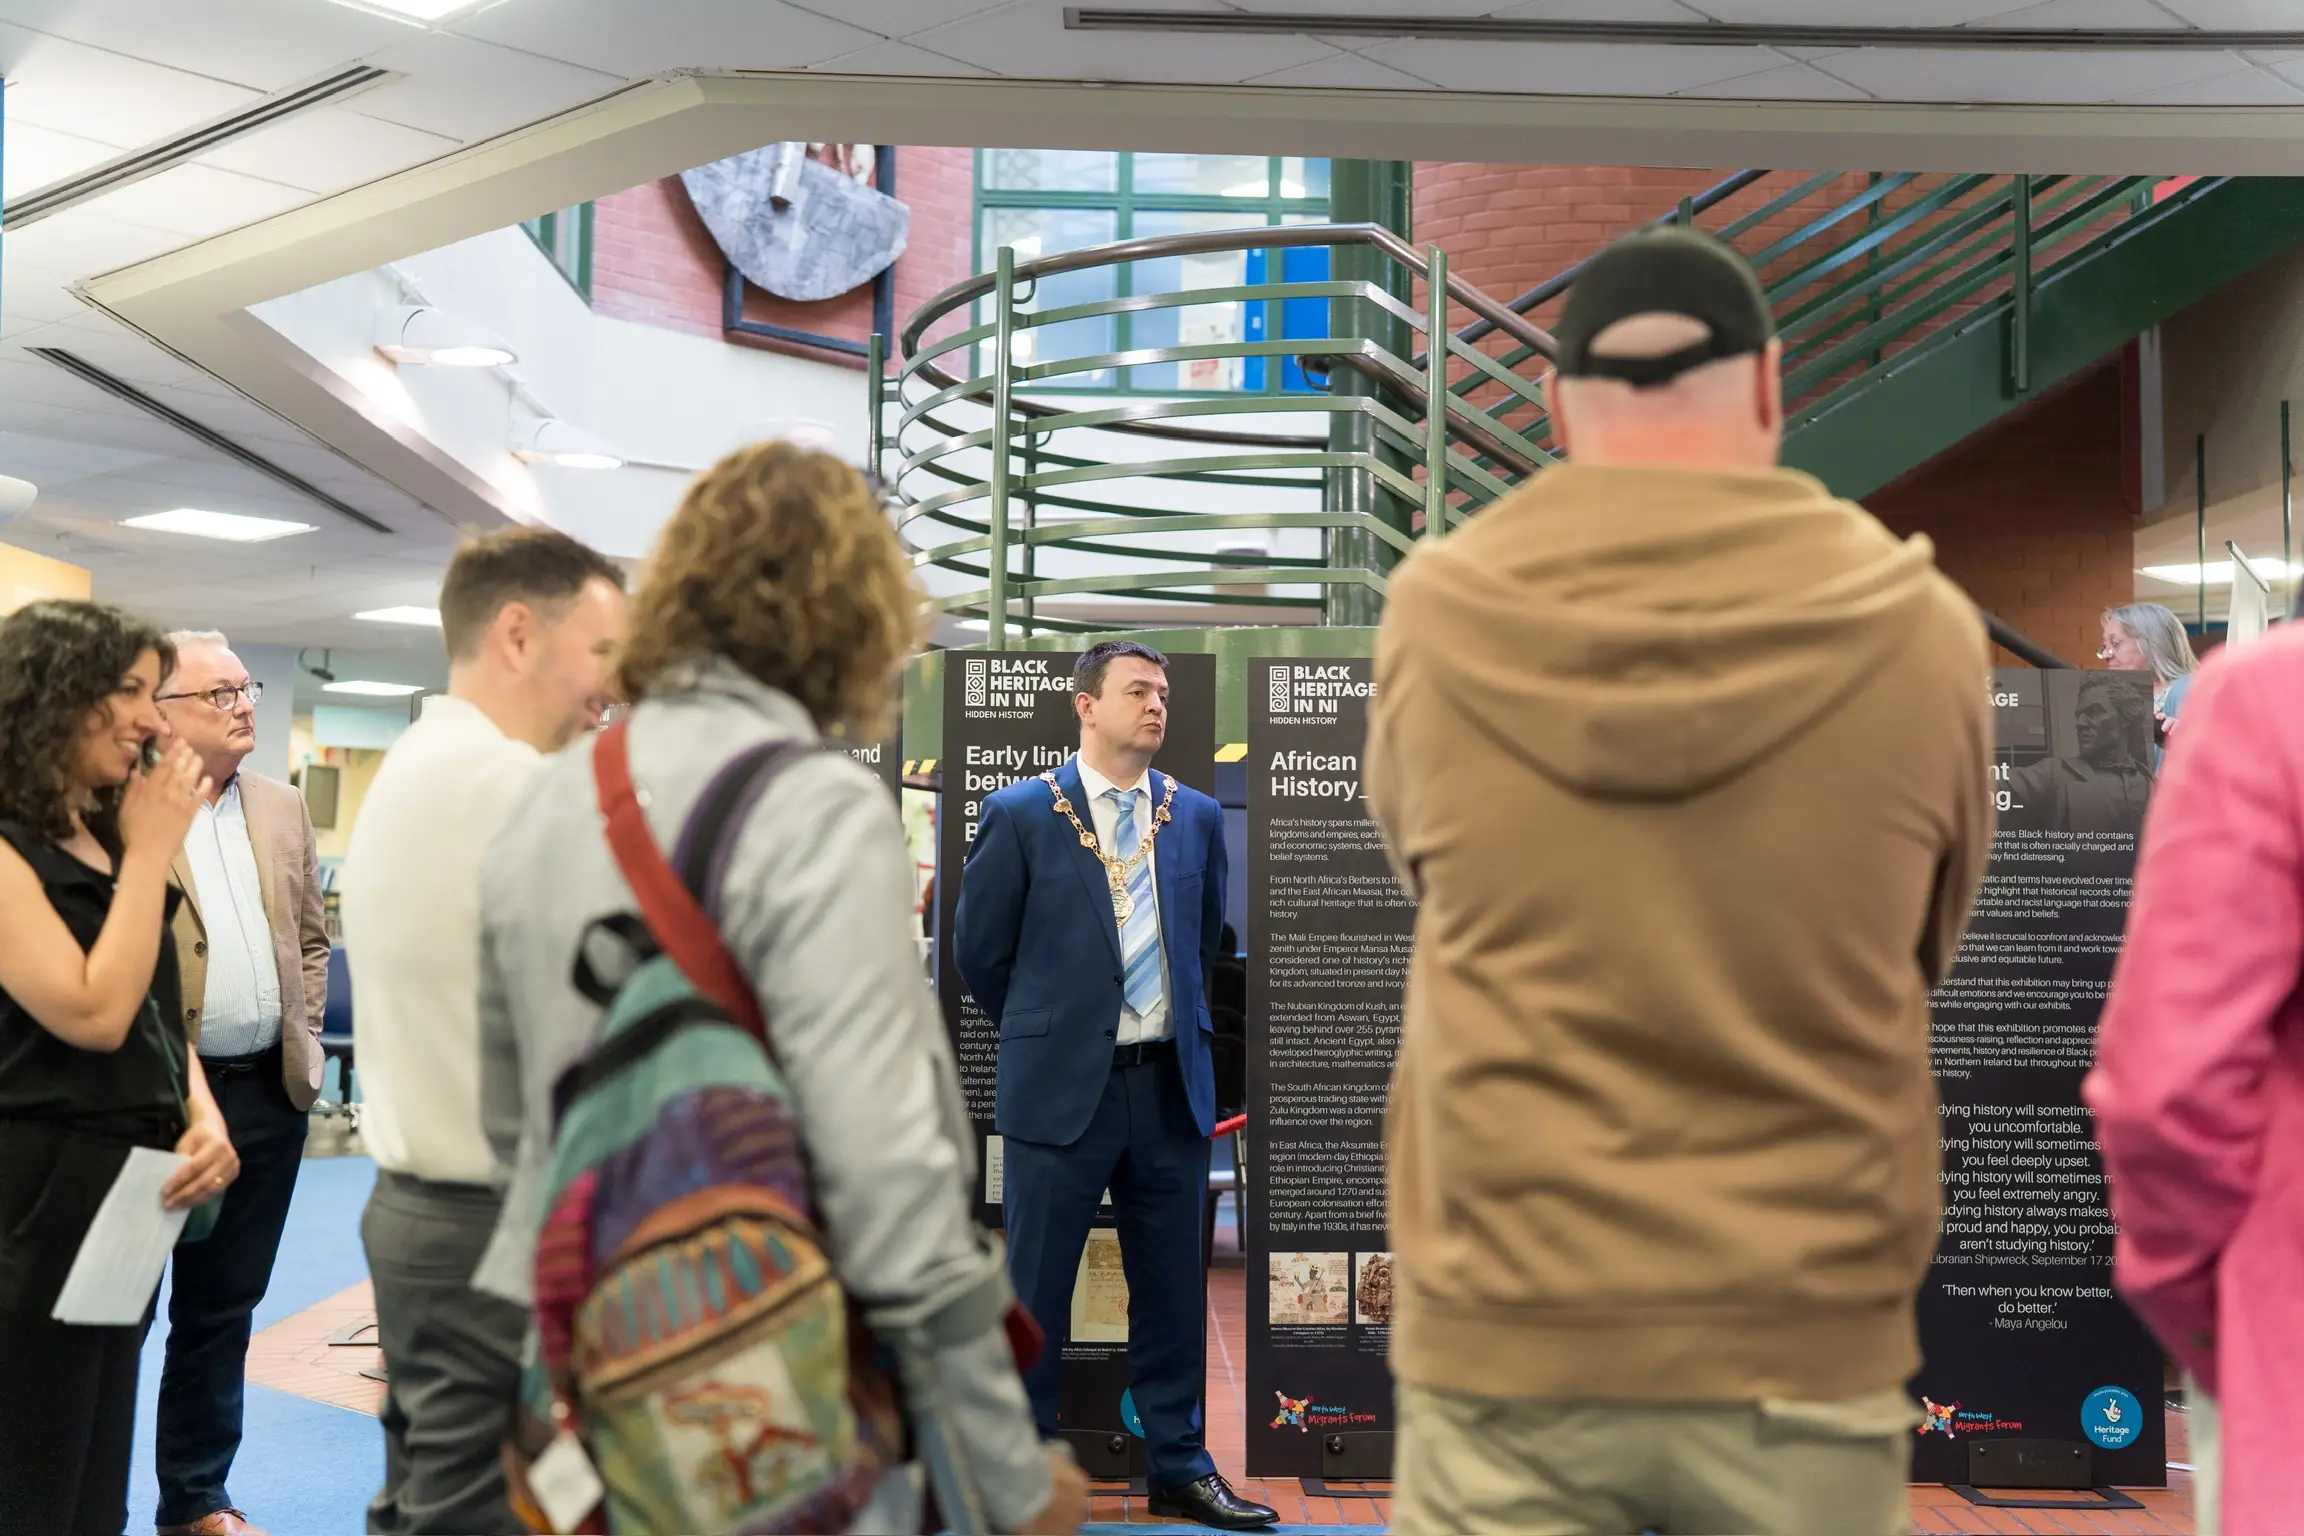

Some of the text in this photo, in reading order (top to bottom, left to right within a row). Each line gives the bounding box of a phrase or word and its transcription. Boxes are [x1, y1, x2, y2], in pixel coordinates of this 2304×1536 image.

[991, 660, 1048, 673] BLACK
[1295, 666, 1350, 679] BLACK
[991, 676, 1075, 691] HERITAGE
[1294, 682, 1378, 697] HERITAGE
[991, 693, 1034, 707] IN NI
[1295, 699, 1337, 712] IN NI
[966, 745, 1078, 771] Early link
[1270, 751, 1356, 770] African
[965, 770, 1036, 791] betw
[1270, 818, 1352, 828] Africa's history spans
[1270, 830, 1309, 840] kingdoms
[1310, 830, 1325, 838] and
[1361, 830, 1381, 838] each
[2019, 830, 2042, 838] Black
[2045, 830, 2074, 840] history
[2077, 831, 2093, 839] and
[2004, 841, 2019, 849] that
[2029, 841, 2050, 849] often
[2053, 842, 2080, 851] racially
[2082, 842, 2116, 852] charged
[2118, 843, 2133, 851] and
[1294, 854, 1329, 862] systems.
[2004, 852, 2019, 860] find
[2021, 853, 2065, 863] distressing.
[1270, 876, 1291, 884] From
[1293, 876, 1316, 884] North
[1318, 875, 1347, 884] Africa's
[1349, 876, 1380, 884] Berbers
[1986, 909, 2013, 917] values
[2032, 910, 2059, 918] beliefs.
[1271, 933, 1286, 941] The
[1309, 934, 1338, 942] Empire
[1341, 933, 1381, 941] flourished
[1394, 933, 1416, 941] West
[1981, 955, 1996, 963] and
[1998, 955, 2036, 964] equitable
[2038, 955, 2063, 963] future.
[1270, 979, 1281, 987] for
[1386, 978, 1406, 989] ivory
[1940, 1000, 1962, 1008] while
[1963, 1001, 2002, 1010] engaging
[2004, 1001, 2021, 1009] with
[1932, 1023, 2086, 1034] hope that this exhibition promotes
[960, 1043, 992, 1052] century
[1314, 1037, 1345, 1045] Ancient
[1349, 1037, 1374, 1047] Egypt,
[1378, 1037, 1395, 1045] also
[960, 1053, 983, 1061] North
[1984, 1058, 2011, 1066] Ireland
[2014, 1058, 2027, 1066] but
[2031, 1059, 2076, 1068] throughout
[2079, 1059, 2093, 1067] the
[1936, 1103, 1970, 1118] dying
[1974, 1104, 2012, 1118] history
[2015, 1104, 2034, 1115] will
[1270, 1117, 1308, 1125] influence
[1345, 1118, 1373, 1128] region.
[1969, 1121, 2083, 1134] you uncomfortable.
[1936, 1136, 2102, 1153] dying history will sometimes
[1270, 1153, 1384, 1162] region (modern-day Ethiopia
[1962, 1154, 2090, 1169] you feel deeply upset.
[1936, 1170, 2101, 1185] dying history will sometimes
[1954, 1187, 2099, 1203] you feel extremely angry.
[1939, 1203, 2108, 1219] udying history always makes
[1947, 1221, 1982, 1235] proud
[1985, 1221, 2007, 1233] and
[2011, 1221, 2050, 1236] happy,
[2054, 1224, 2076, 1236] you
[1996, 1239, 2046, 1253] studying
[1975, 1254, 2028, 1266] Shipwreck,
[2032, 1255, 2087, 1266] September
[2091, 1256, 2102, 1265] 17
[1978, 1285, 2012, 1296] when
[2015, 1288, 2036, 1299] you
[2041, 1285, 2073, 1297] know
[2076, 1286, 2112, 1298] better,
[1998, 1302, 2014, 1313] do
[1995, 1318, 2022, 1330] Maya
[2025, 1318, 2067, 1331] Angelou
[1308, 1414, 1348, 1426] Migrants
[2095, 1426, 2129, 1436] Heritage
[2103, 1434, 2122, 1442] Fund
